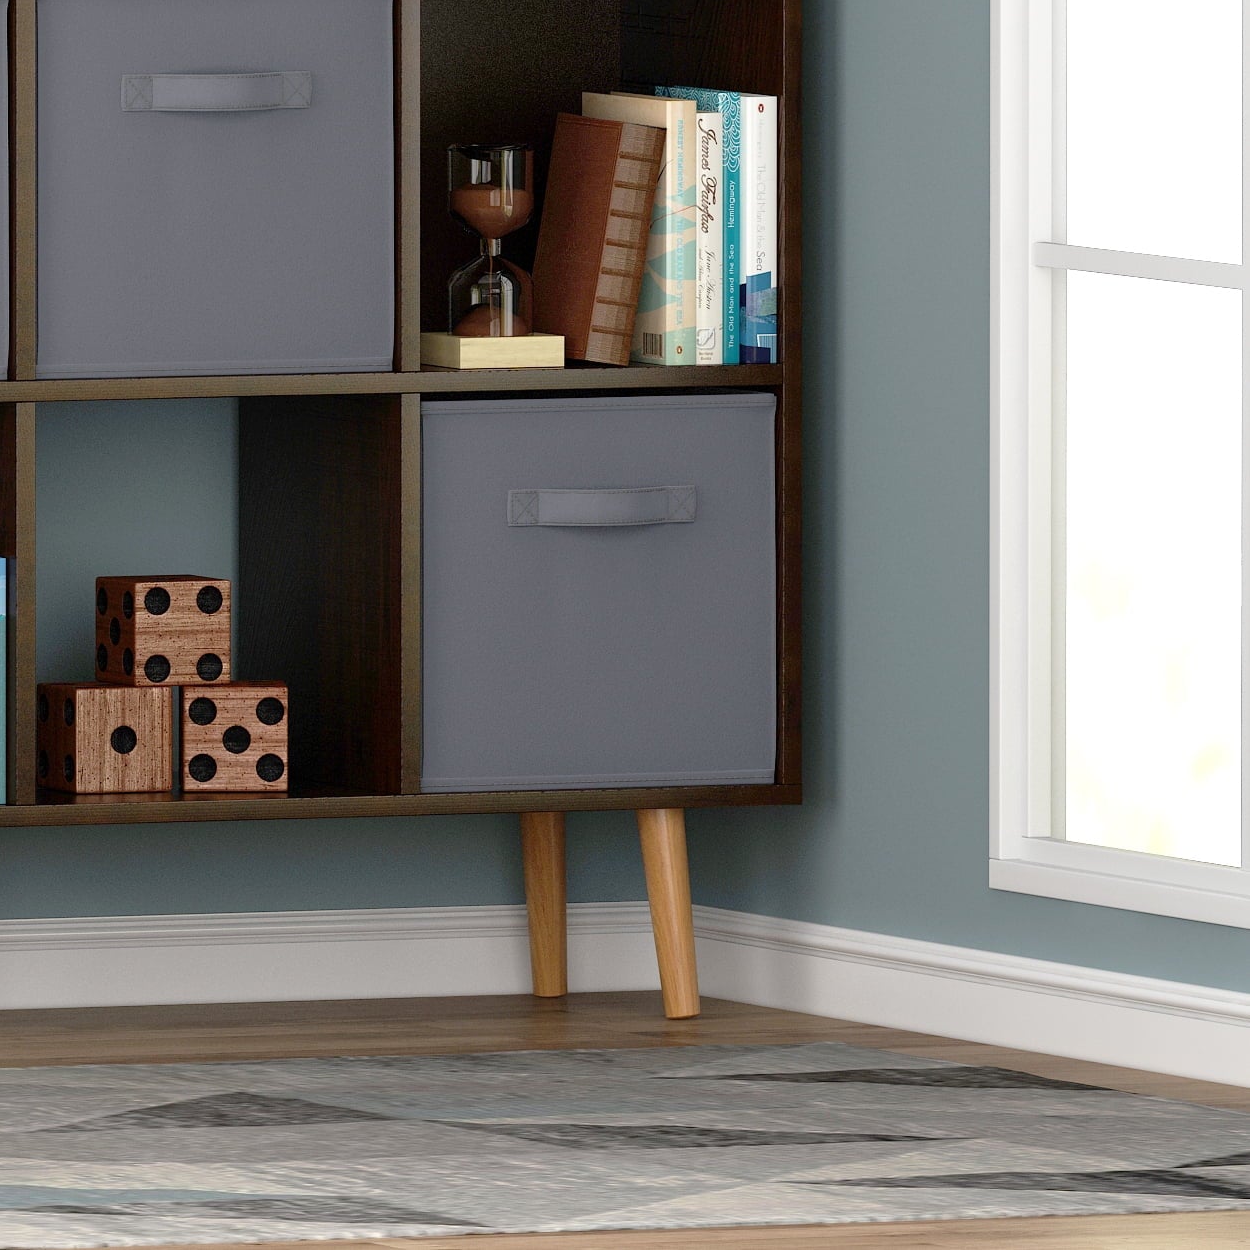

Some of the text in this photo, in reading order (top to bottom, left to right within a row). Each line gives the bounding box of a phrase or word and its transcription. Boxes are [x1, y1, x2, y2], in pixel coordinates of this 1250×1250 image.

[698, 118, 718, 234] James Fairfax
[727, 180, 736, 228] Hemingway
[756, 251, 766, 271] Sea
